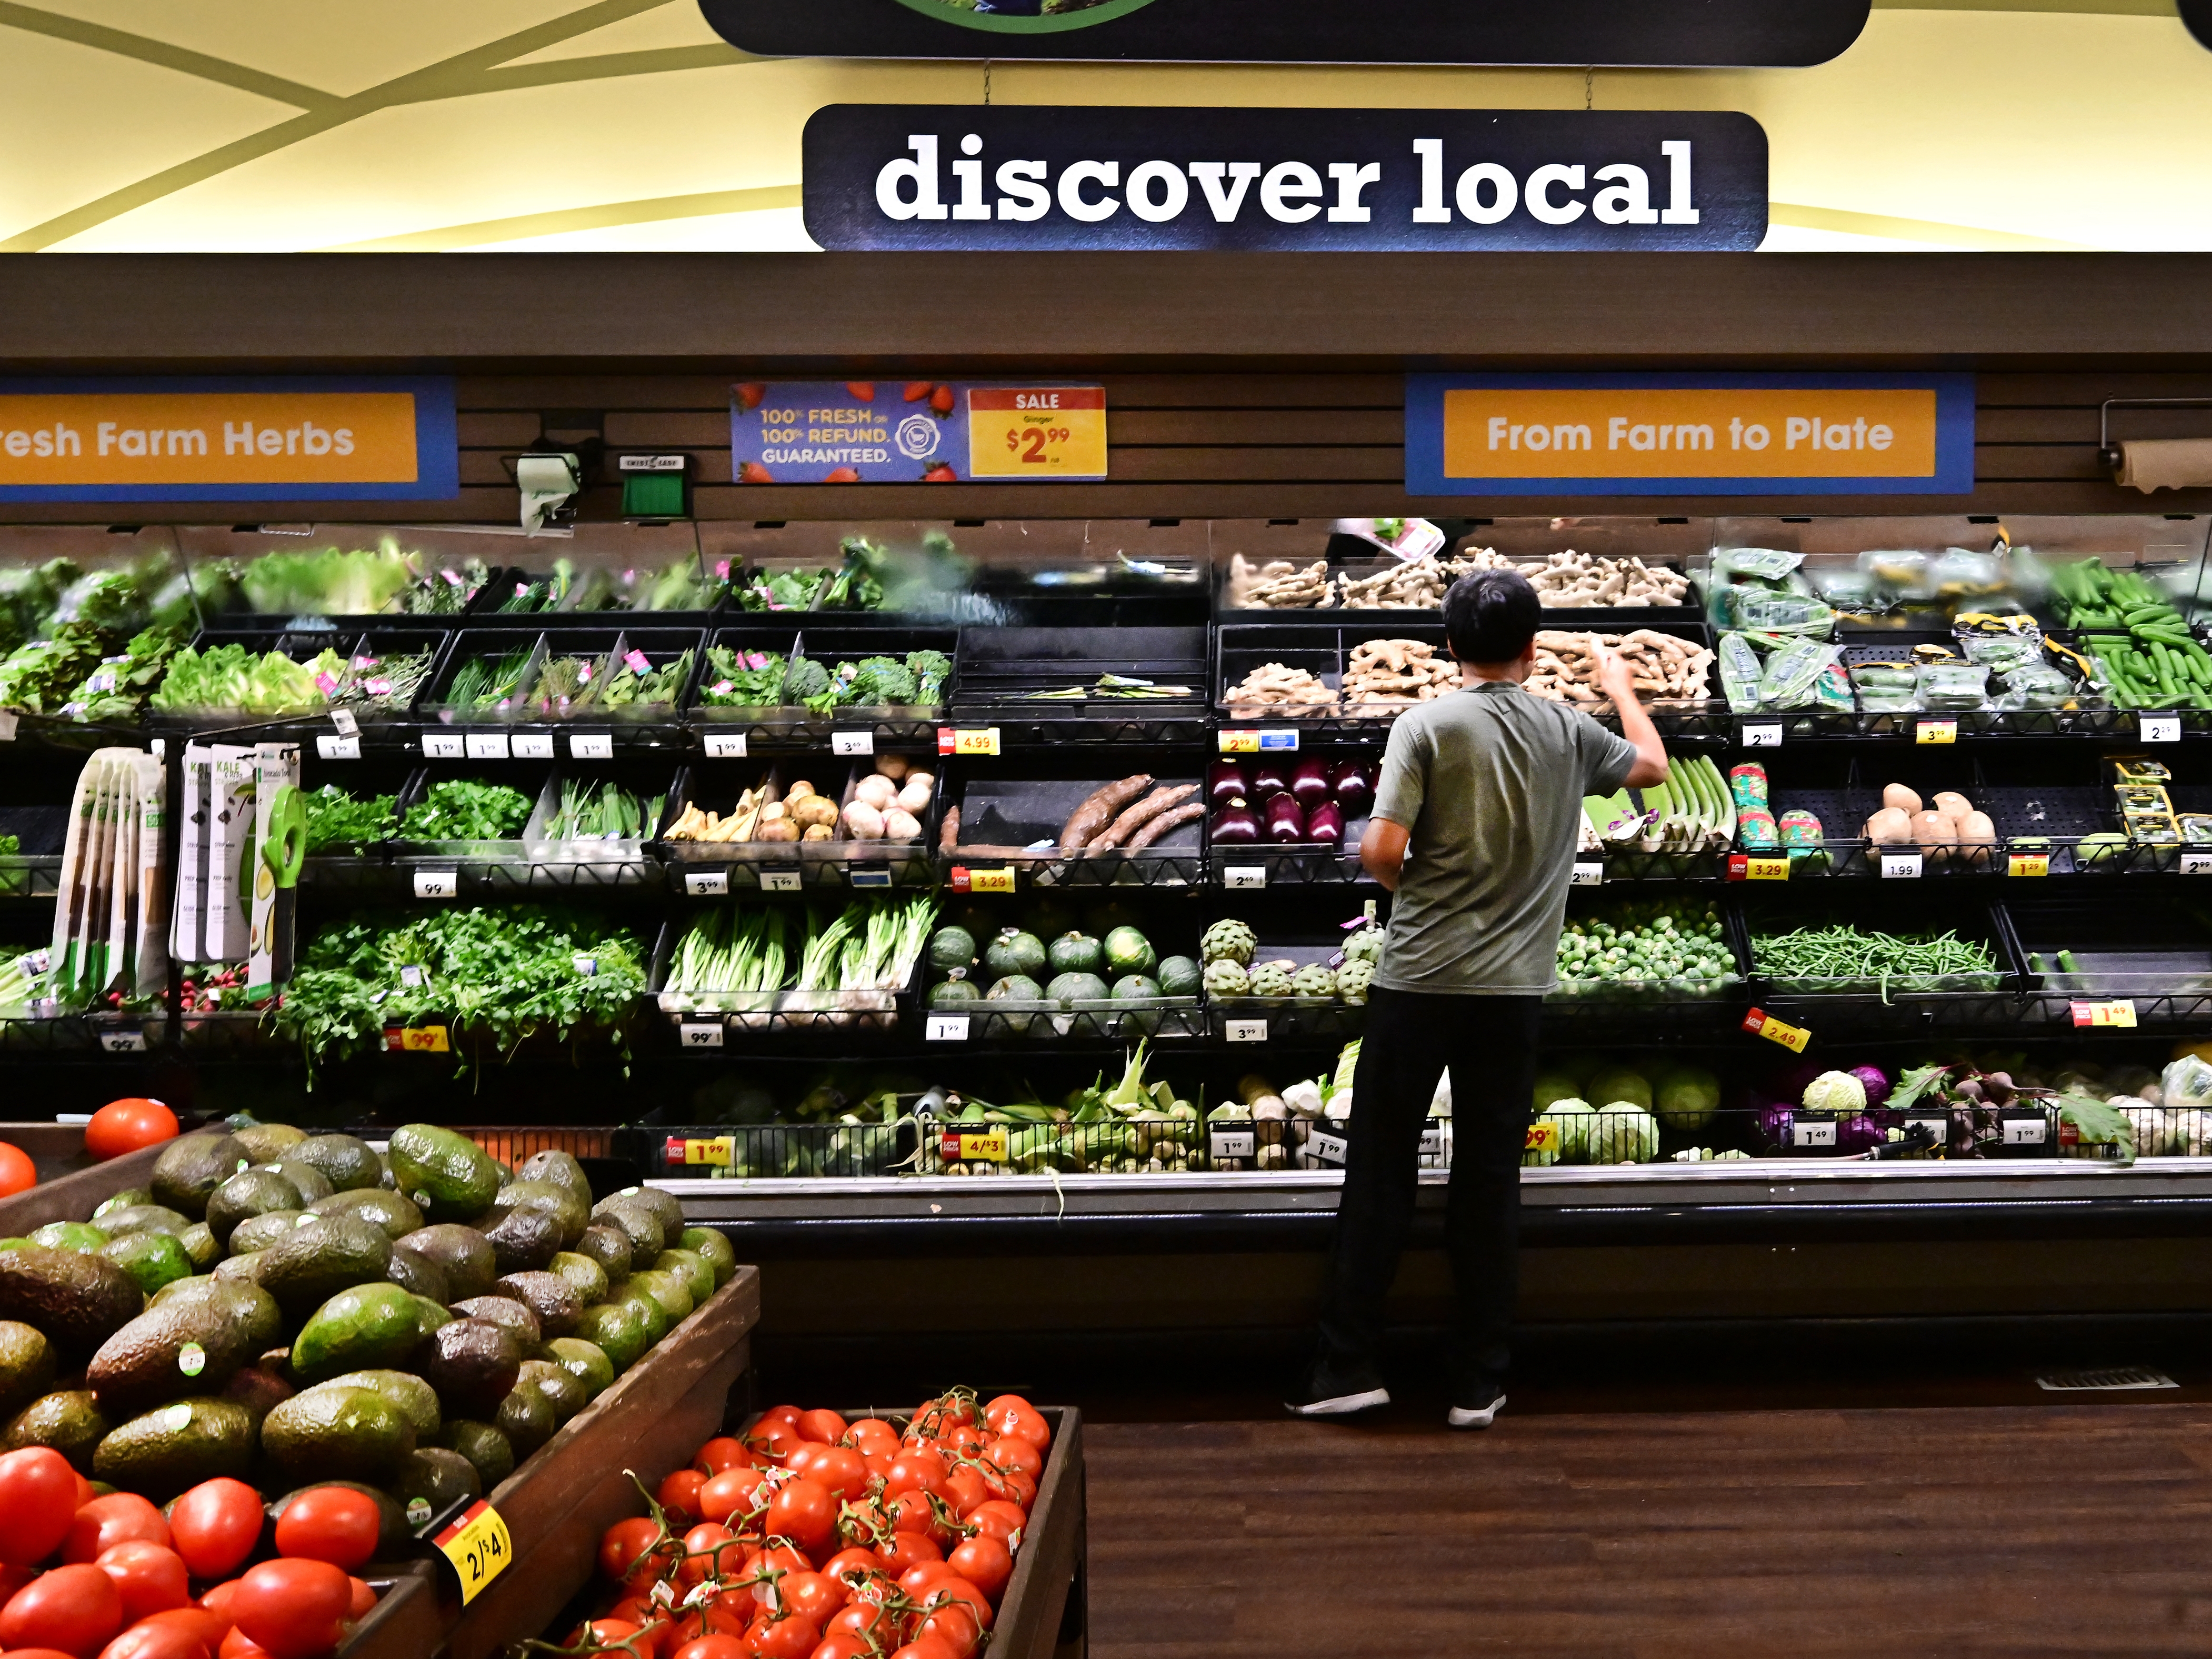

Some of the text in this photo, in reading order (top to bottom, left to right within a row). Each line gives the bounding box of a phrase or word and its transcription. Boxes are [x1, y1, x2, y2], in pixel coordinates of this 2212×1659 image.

[876, 133, 1699, 225] discover local
[1016, 394, 1059, 409] SALE
[761, 409, 804, 424] 100%
[808, 409, 871, 424] FRESH
[1024, 416, 1054, 425] Ginger
[0, 421, 354, 457] esh Farm Herbs
[762, 428, 890, 443] 100% REFUND.
[1488, 417, 1894, 450] From Farm to Plate
[762, 448, 891, 463] GUARANTEED.
[964, 737, 989, 747] 4.99
[217, 761, 240, 774] KALE
[1755, 865, 1781, 875] 3.29
[1890, 866, 1913, 875] 1.99
[979, 876, 1005, 887] 3.29
[1768, 1027, 1796, 1045] 2.49
[467, 1532, 502, 1581] 2/$4
